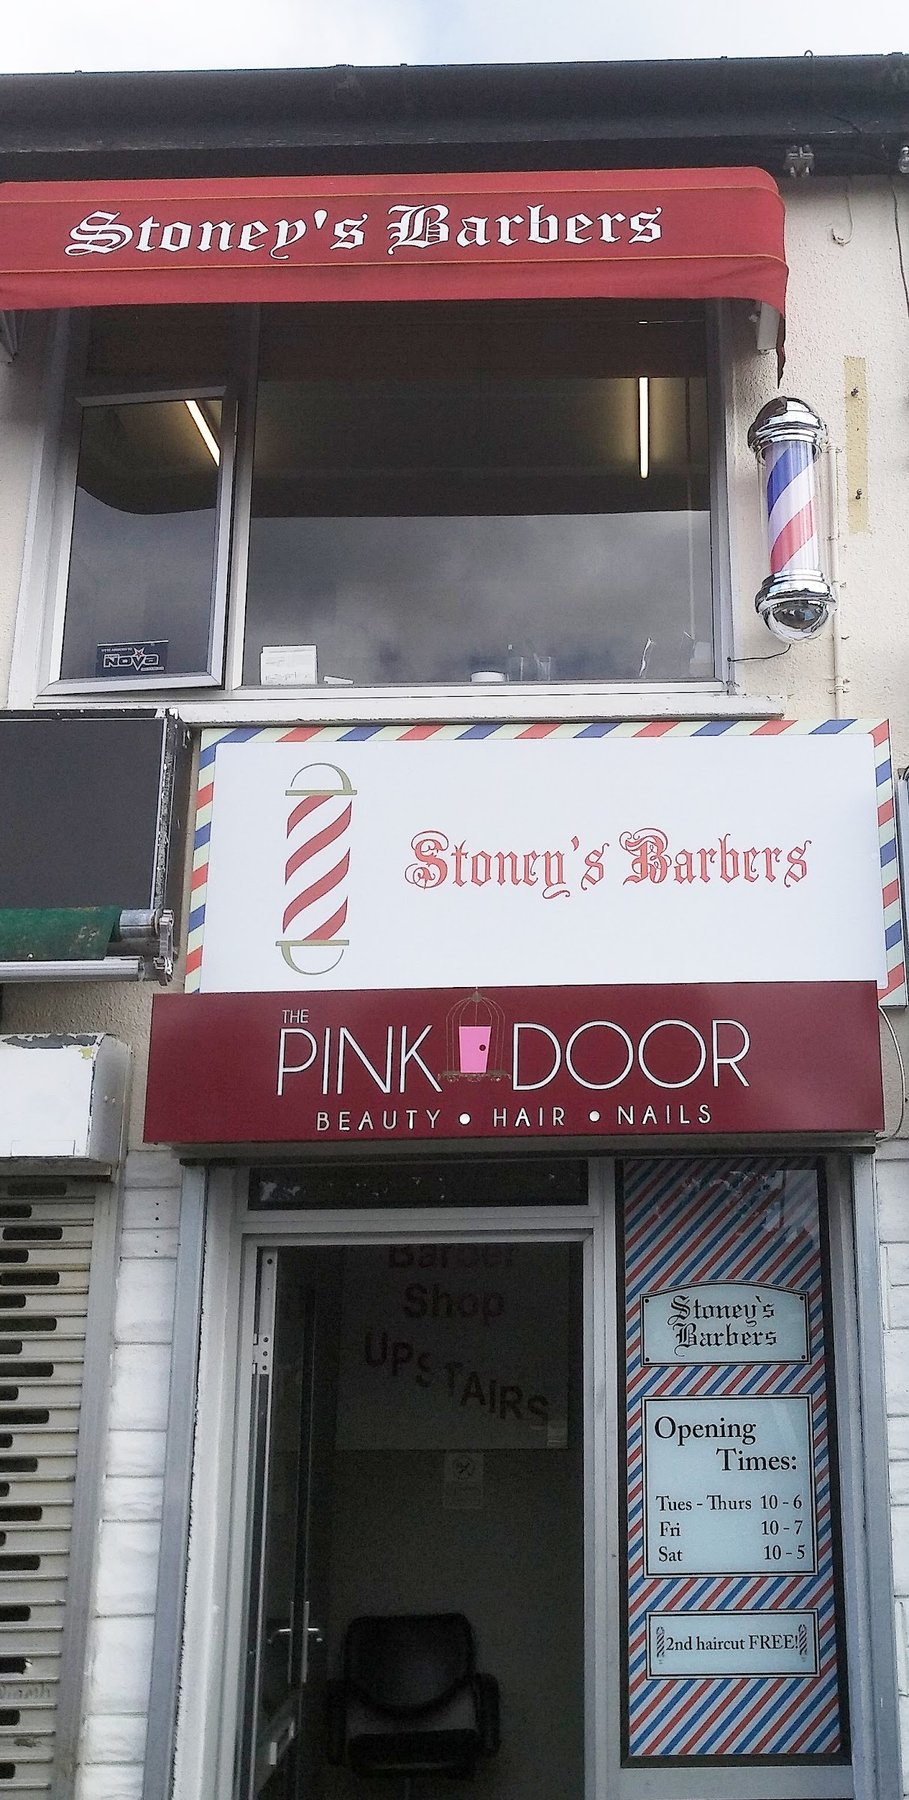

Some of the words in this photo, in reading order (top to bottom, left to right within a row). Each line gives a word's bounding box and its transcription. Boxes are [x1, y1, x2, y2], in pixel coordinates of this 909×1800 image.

[65, 209, 367, 259] Stoney's
[387, 203, 663, 254] Barbers
[404, 830, 609, 899] Stoney's
[619, 827, 811, 888] Barbers
[282, 1009, 309, 1024] THE
[277, 1024, 443, 1096] PINK
[512, 1019, 750, 1091] DOOR
[316, 1109, 441, 1131] BEAUTY
[493, 1107, 565, 1127] HAIR
[617, 1104, 712, 1126] NAILS
[404, 1283, 505, 1325] Shop
[672, 1322, 777, 1357] Barbers
[654, 1416, 757, 1446] Opening
[716, 1448, 797, 1471] Times:
[656, 1495, 692, 1511] Tues
[706, 1494, 752, 1511] Thurs
[760, 1495, 778, 1510] 10
[793, 1494, 803, 1510] 6
[659, 1521, 681, 1537] Fri
[761, 1520, 779, 1535] 10
[794, 1519, 803, 1535] 7
[658, 1546, 683, 1562] Sat
[763, 1544, 782, 1560] 10
[796, 1544, 805, 1560] 5
[666, 1635, 693, 1651] 2nd
[696, 1636, 745, 1651] haircut
[748, 1634, 799, 1650] FREE!
